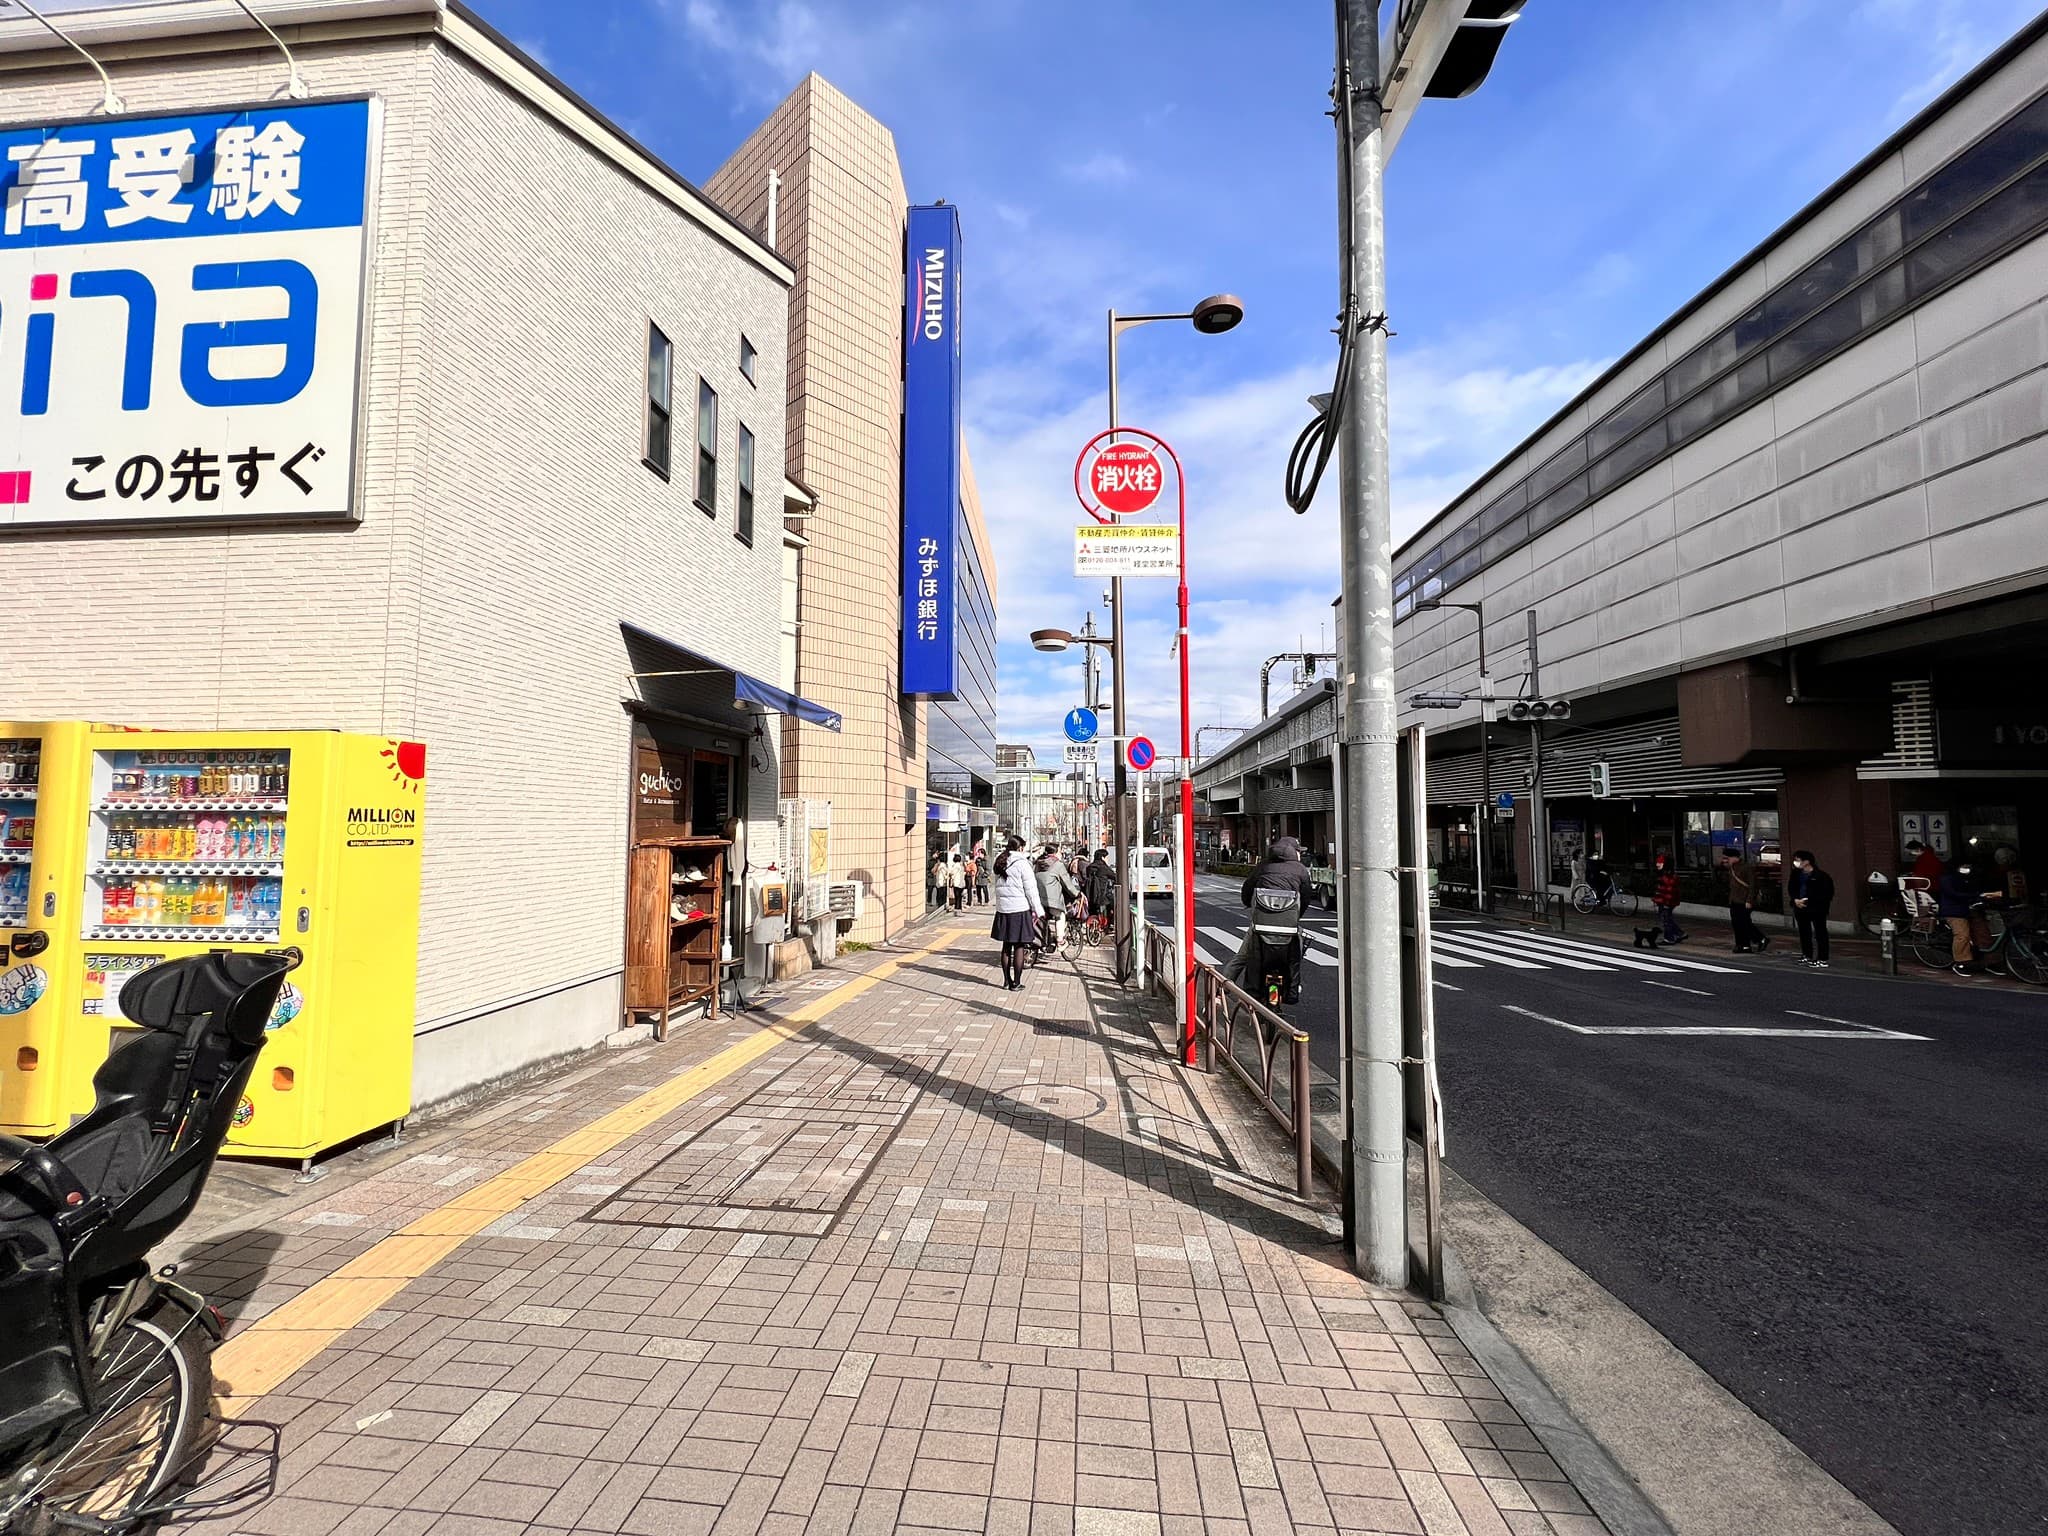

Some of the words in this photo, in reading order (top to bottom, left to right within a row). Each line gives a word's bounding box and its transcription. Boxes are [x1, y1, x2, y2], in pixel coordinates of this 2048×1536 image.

[4, 121, 305, 236] 高受験
[924, 248, 945, 341] MIZUHO
[0, 259, 319, 416] ina
[65, 442, 326, 503] この先すぐ
[1097, 463, 1157, 492] 消火栓
[1102, 452, 1117, 460] FIRE
[1119, 452, 1149, 460] HYDRANT
[918, 538, 939, 640] みずほ銀行
[639, 766, 683, 795] guchico
[347, 808, 415, 823] MILLION
